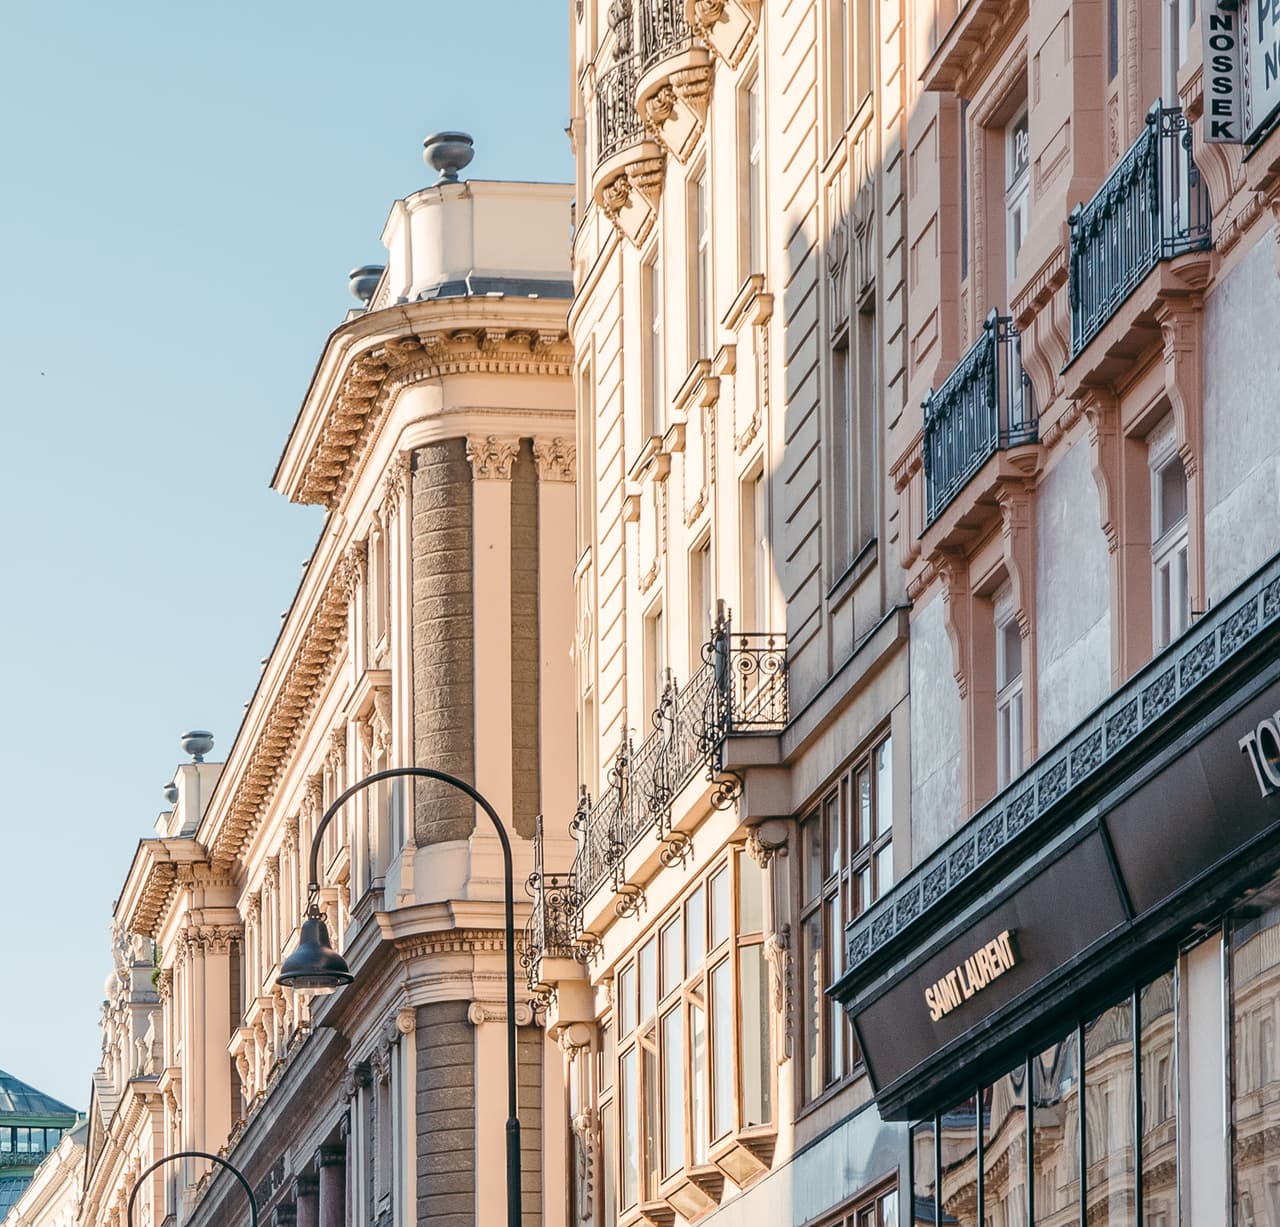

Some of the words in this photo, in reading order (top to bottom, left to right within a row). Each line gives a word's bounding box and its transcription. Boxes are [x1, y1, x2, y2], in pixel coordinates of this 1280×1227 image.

[1209, 14, 1235, 139] NOSSEK
[1238, 709, 1280, 798] TO
[925, 969, 963, 1022] SAINT
[956, 930, 1016, 1000] LAURENT
